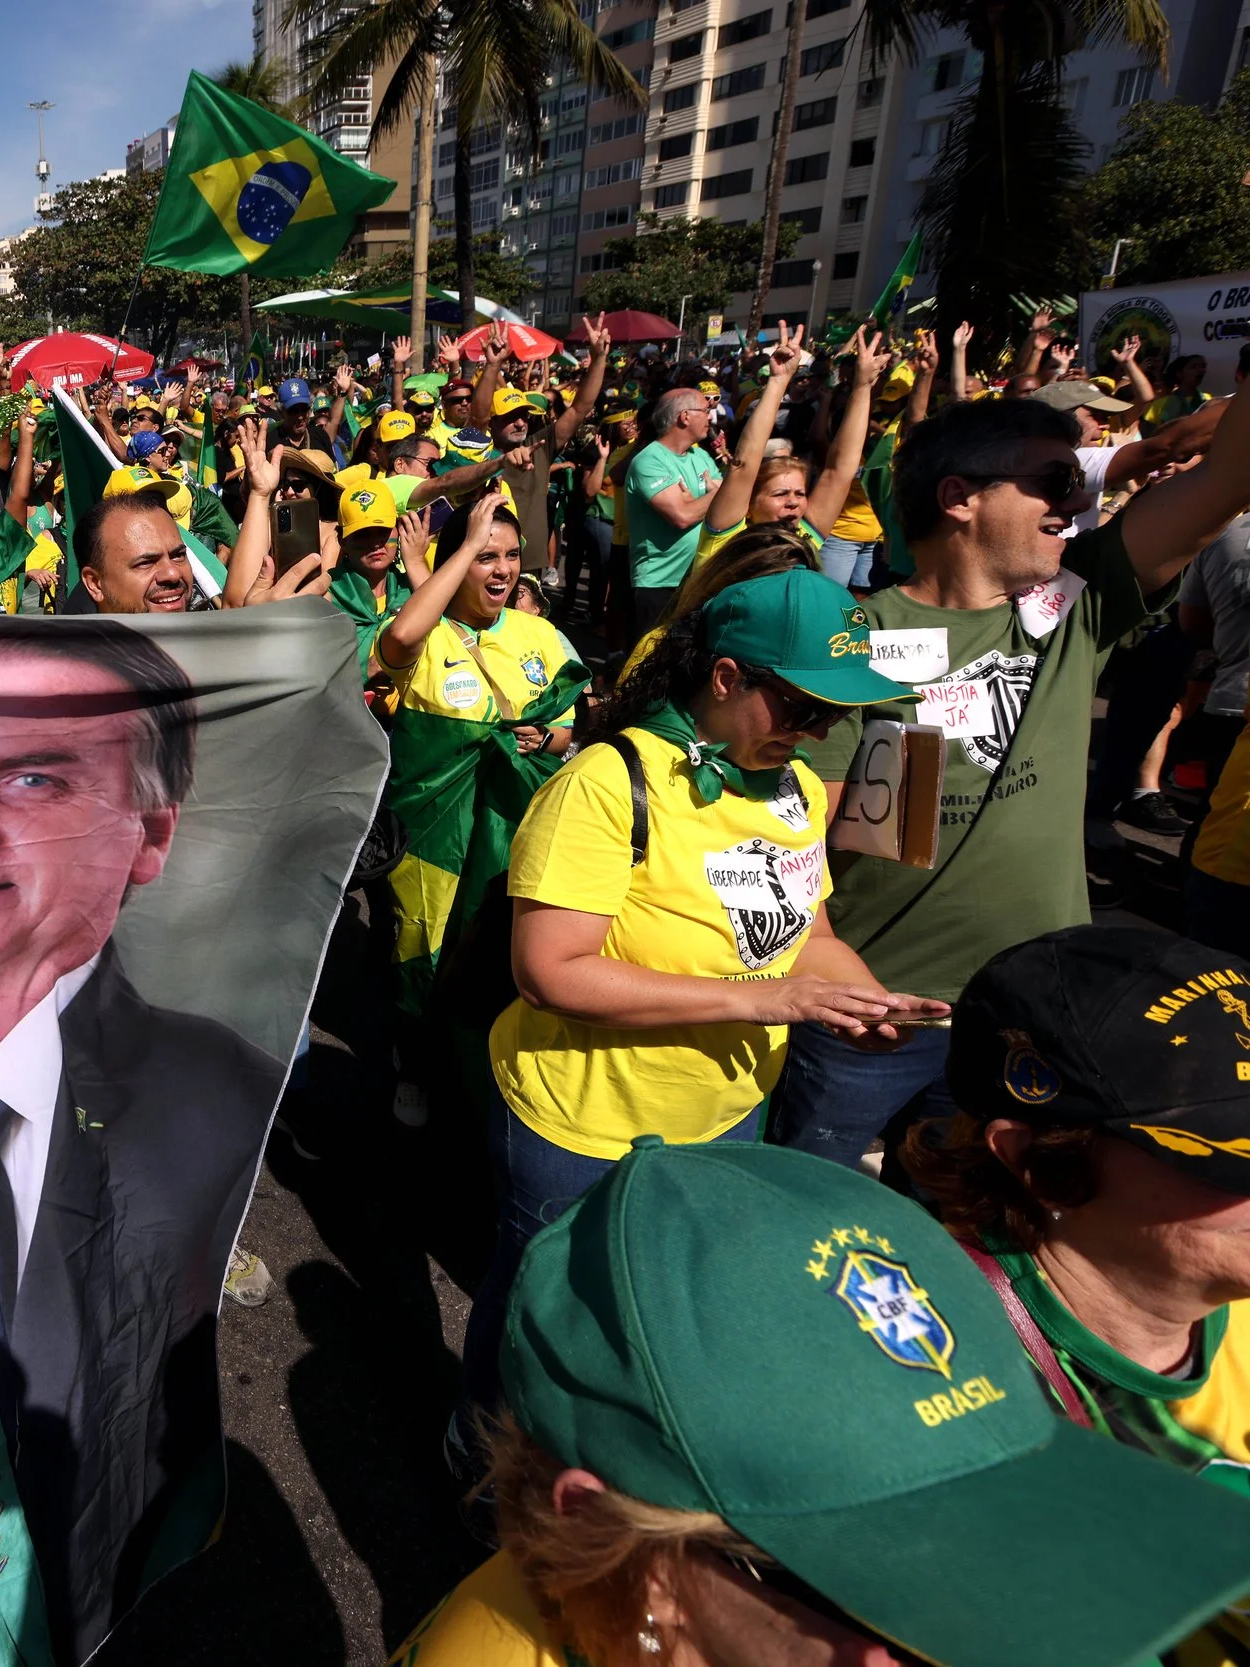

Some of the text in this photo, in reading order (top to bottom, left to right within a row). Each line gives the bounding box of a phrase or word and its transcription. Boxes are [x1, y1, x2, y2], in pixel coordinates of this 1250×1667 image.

[1207, 286, 1250, 311] O BR
[1038, 592, 1066, 620] NÃO
[828, 632, 870, 658] Bra
[945, 704, 969, 727] JÁ
[1144, 969, 1244, 1024] MARINHA
[877, 1297, 908, 1319] CBF
[914, 1375, 1006, 1427] BRASIL
